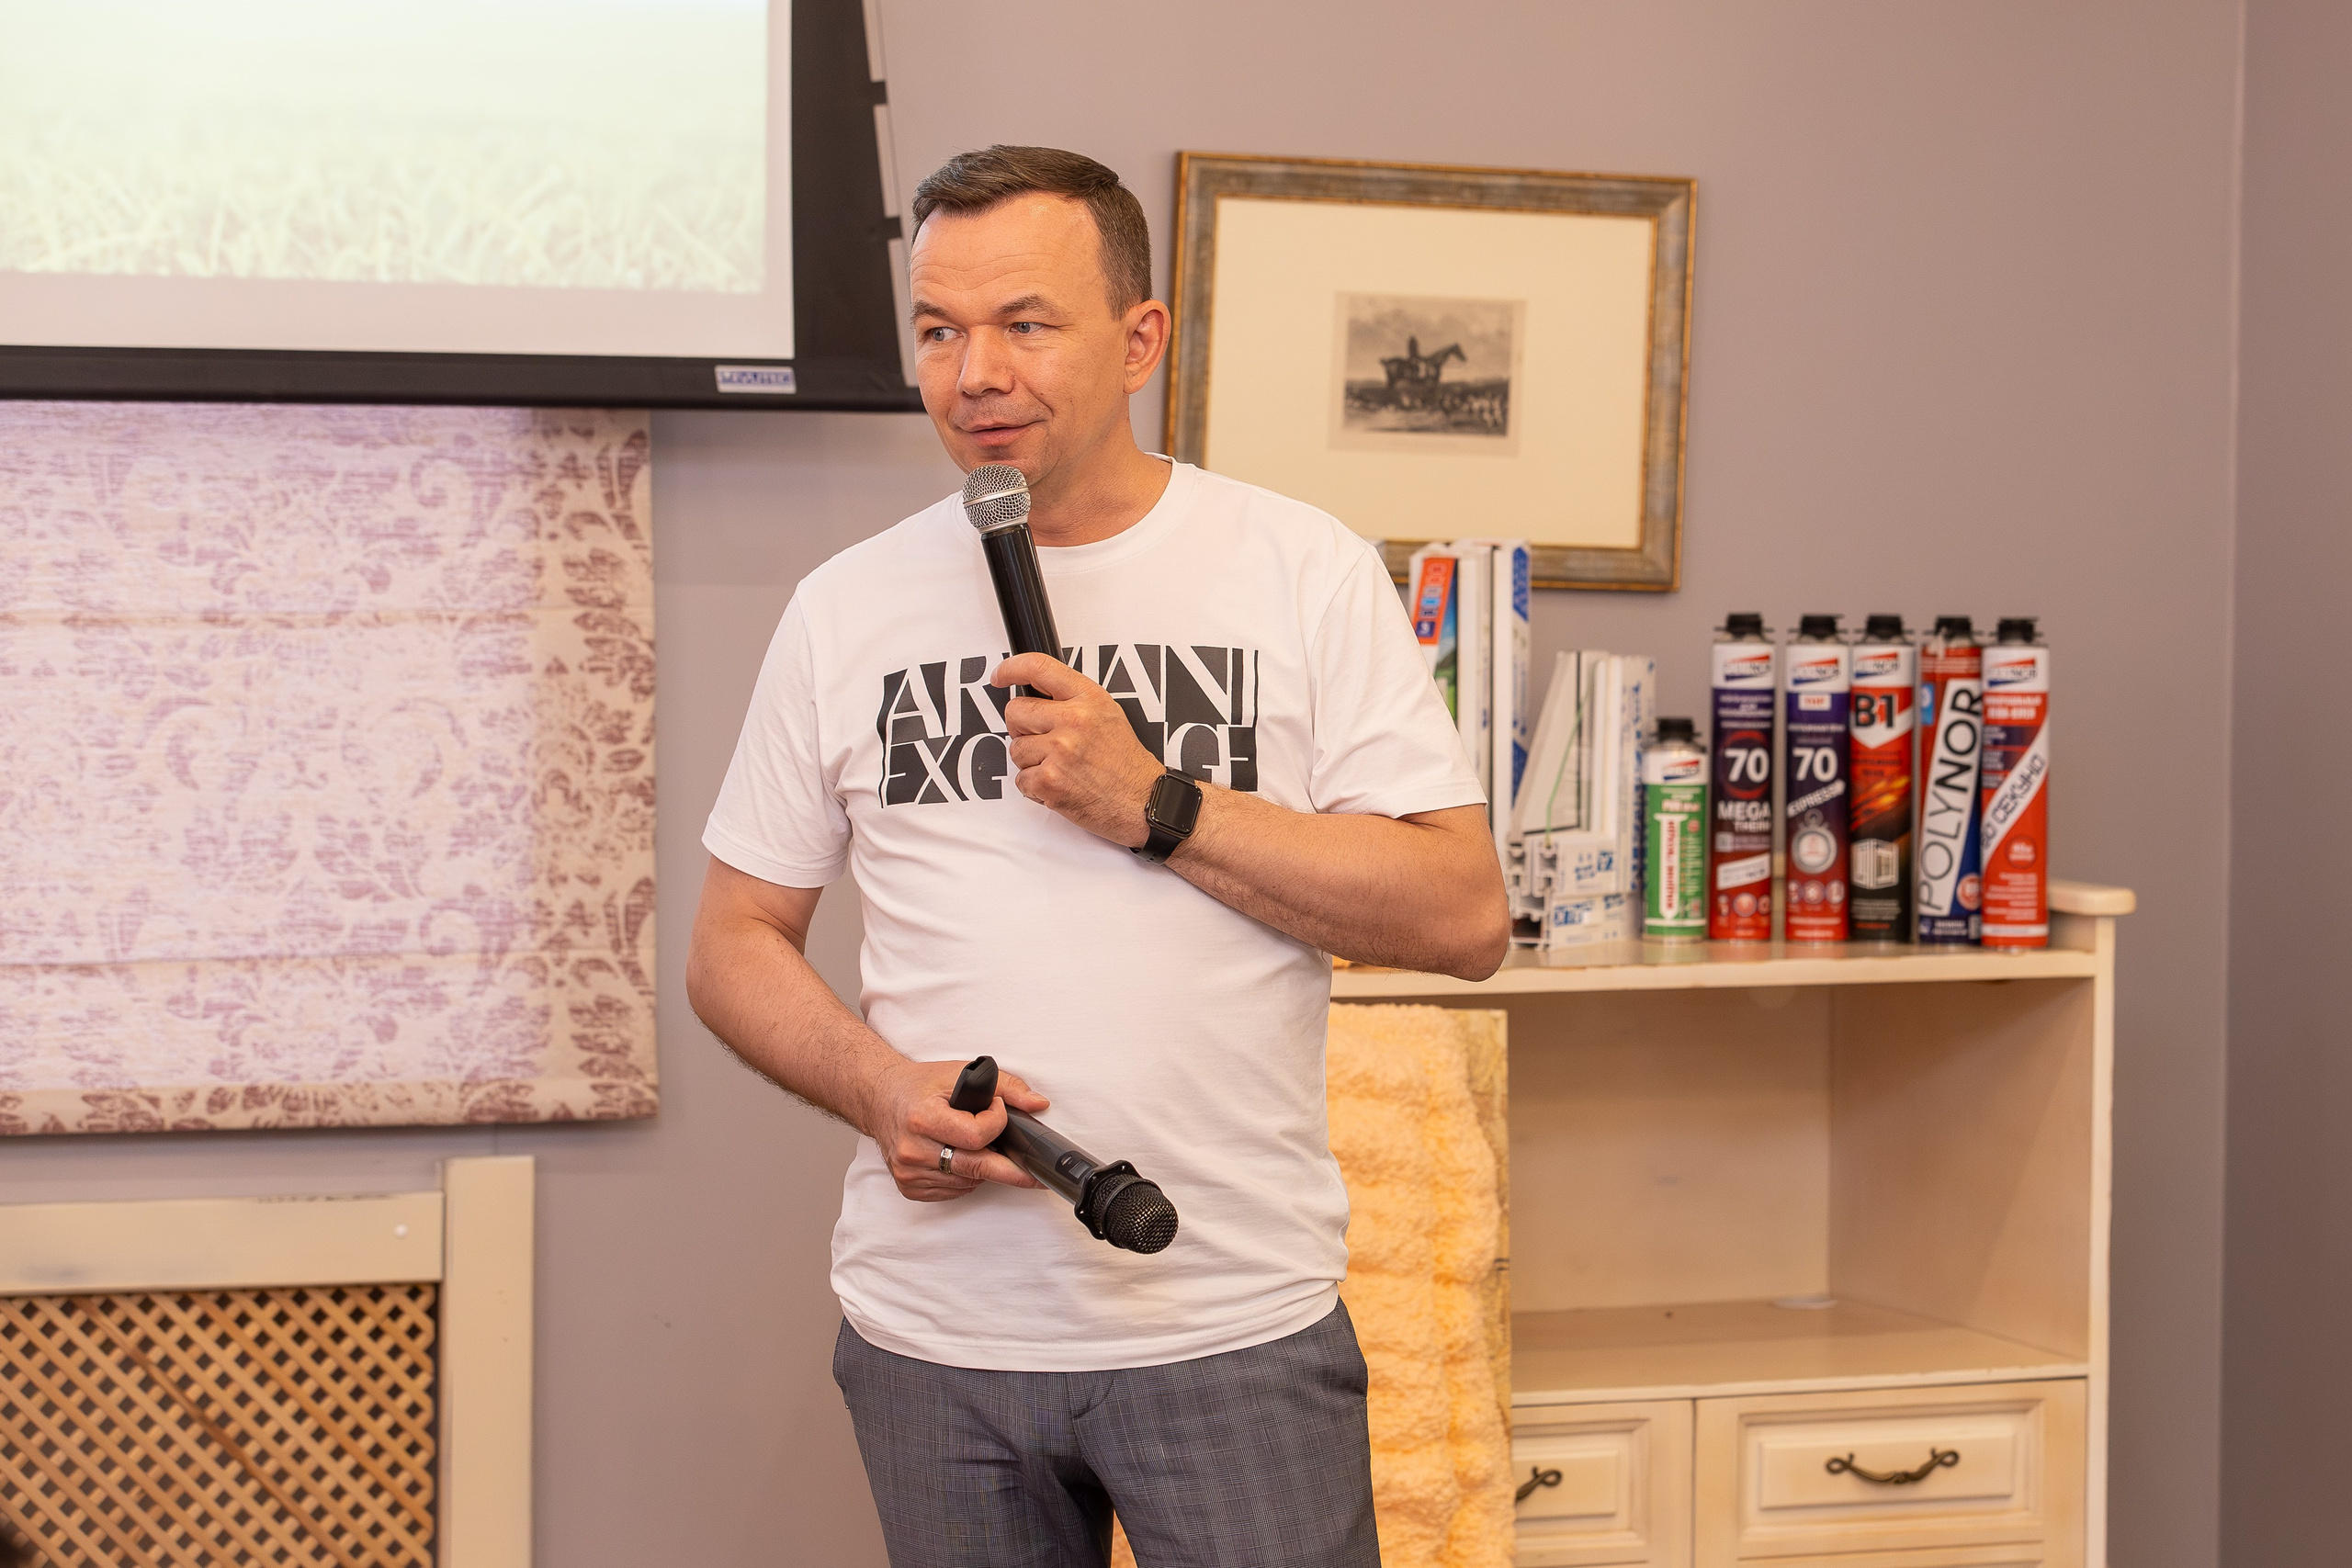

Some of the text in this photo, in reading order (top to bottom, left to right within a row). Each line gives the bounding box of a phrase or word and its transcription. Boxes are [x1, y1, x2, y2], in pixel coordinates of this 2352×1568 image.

[1854, 694, 1894, 729] B1
[1724, 747, 1770, 783] 70
[1792, 746, 1838, 783] 70
[1717, 800, 1771, 821] MEGA
[1918, 688, 1983, 910] POLYNOR
